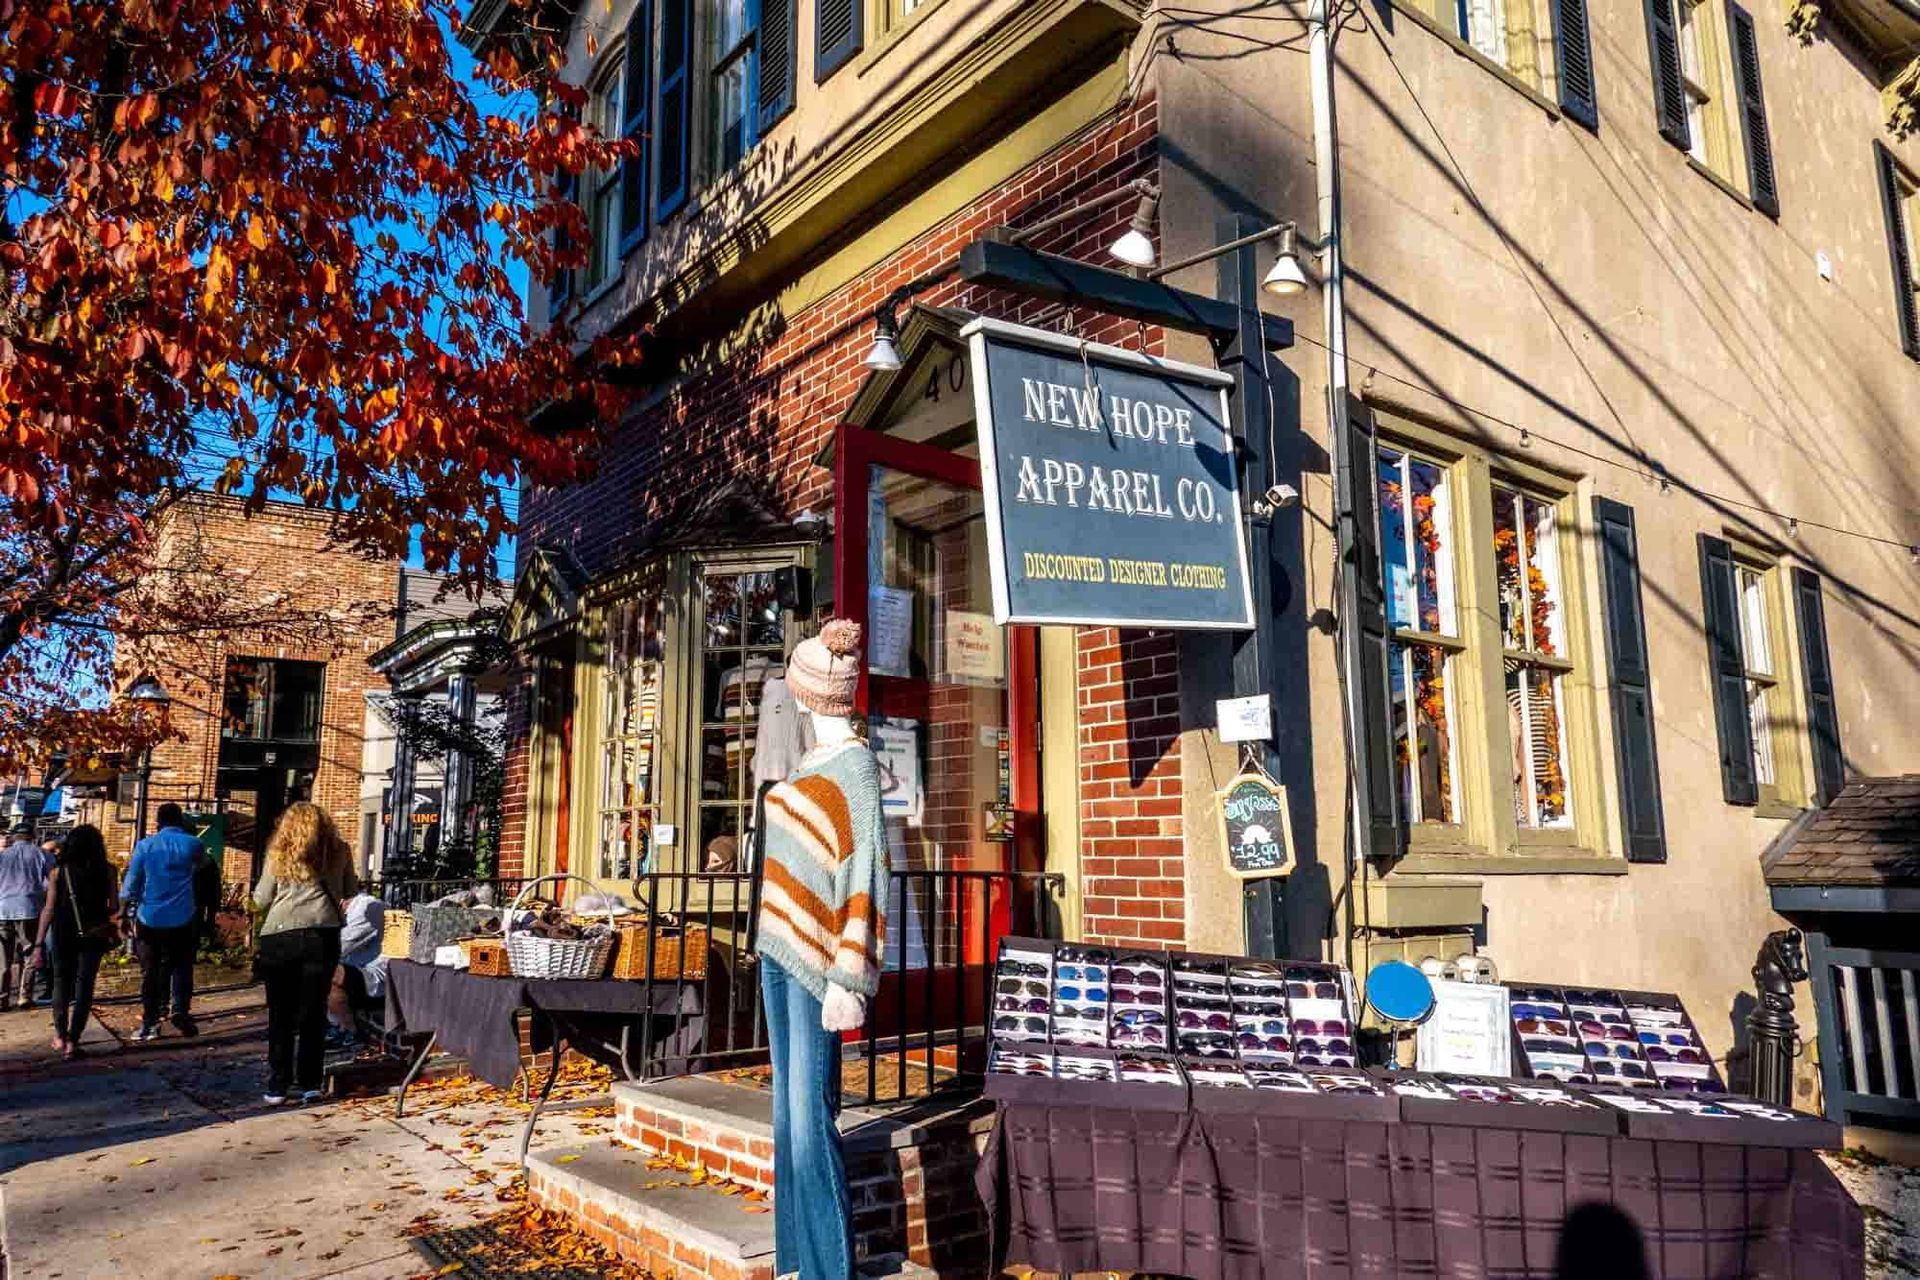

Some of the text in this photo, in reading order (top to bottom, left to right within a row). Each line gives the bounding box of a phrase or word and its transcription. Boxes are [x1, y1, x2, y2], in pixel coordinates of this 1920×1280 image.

[925, 355, 965, 402] 40
[1021, 377, 1196, 448] NEW HOPE
[1016, 456, 1224, 525] APPAREL CO.
[1024, 552, 1226, 590] DISCOUNTED DESIGNER CLOTHING
